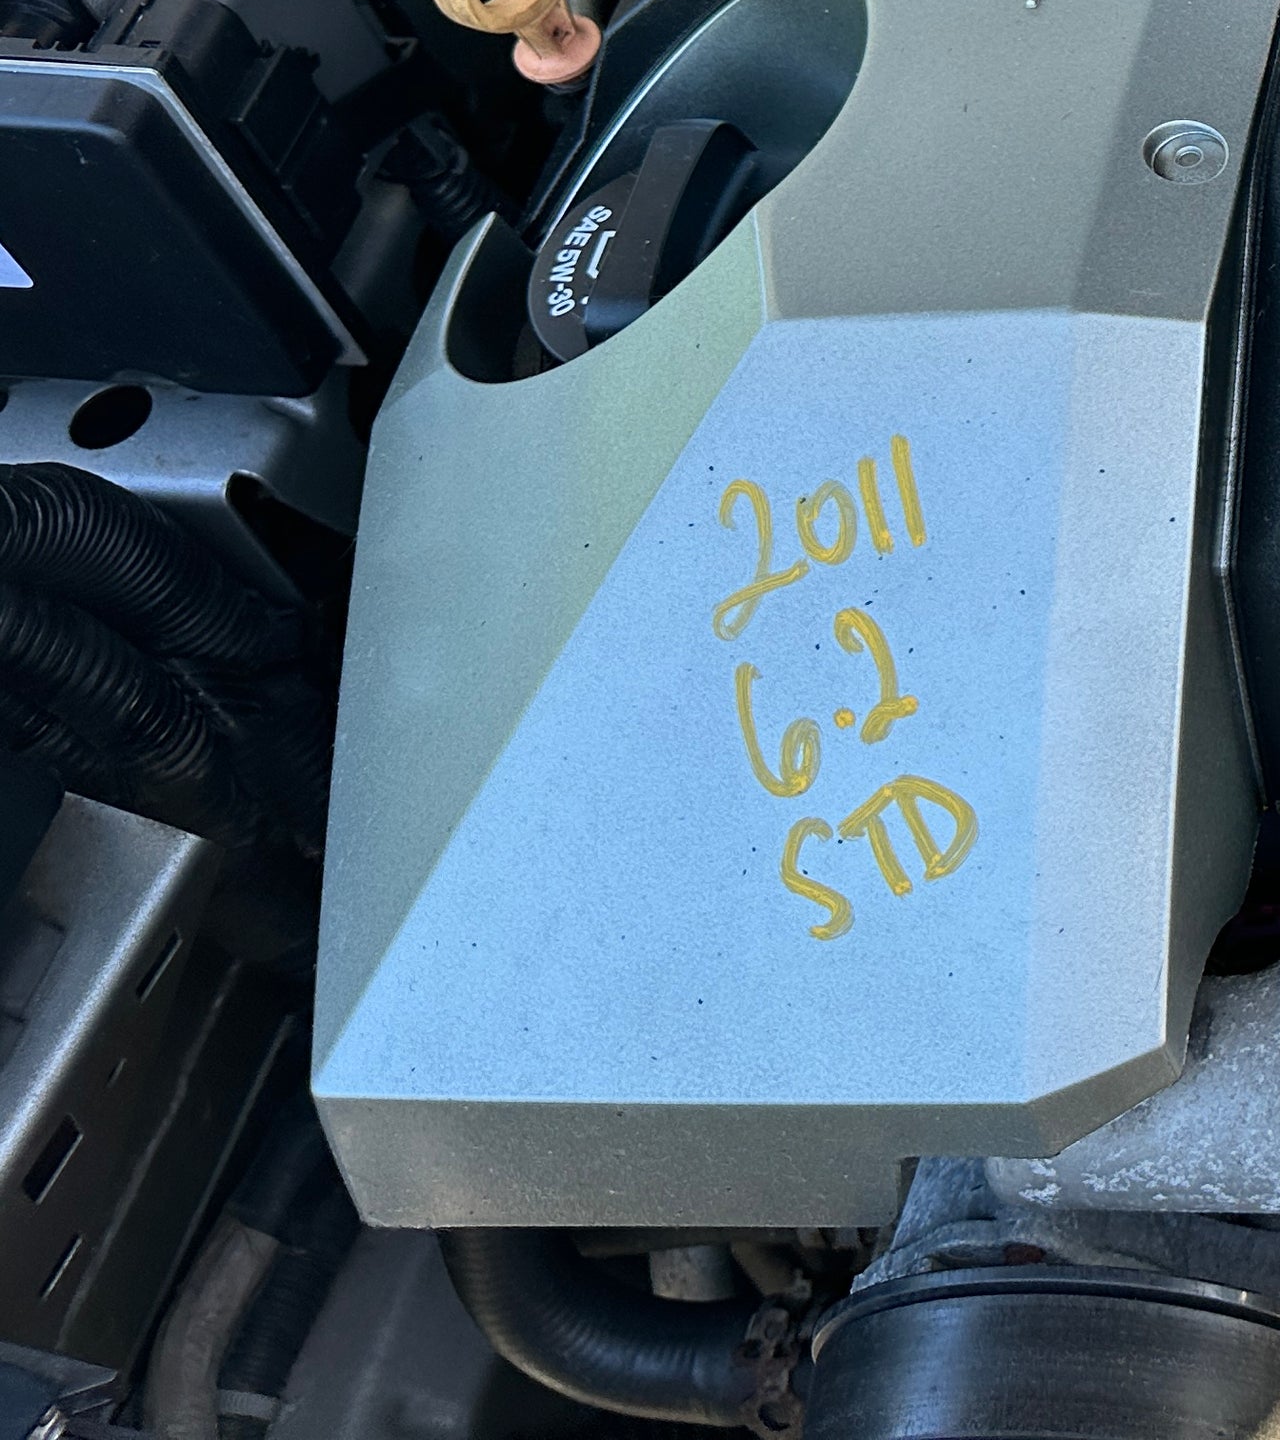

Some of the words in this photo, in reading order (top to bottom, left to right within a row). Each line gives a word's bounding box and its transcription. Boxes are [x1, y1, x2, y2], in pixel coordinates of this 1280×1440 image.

[547, 248, 583, 318] 5W-30
[564, 205, 612, 248] SAE
[712, 434, 927, 641] 2011
[734, 607, 919, 799] 6.2
[781, 774, 979, 942] STD
